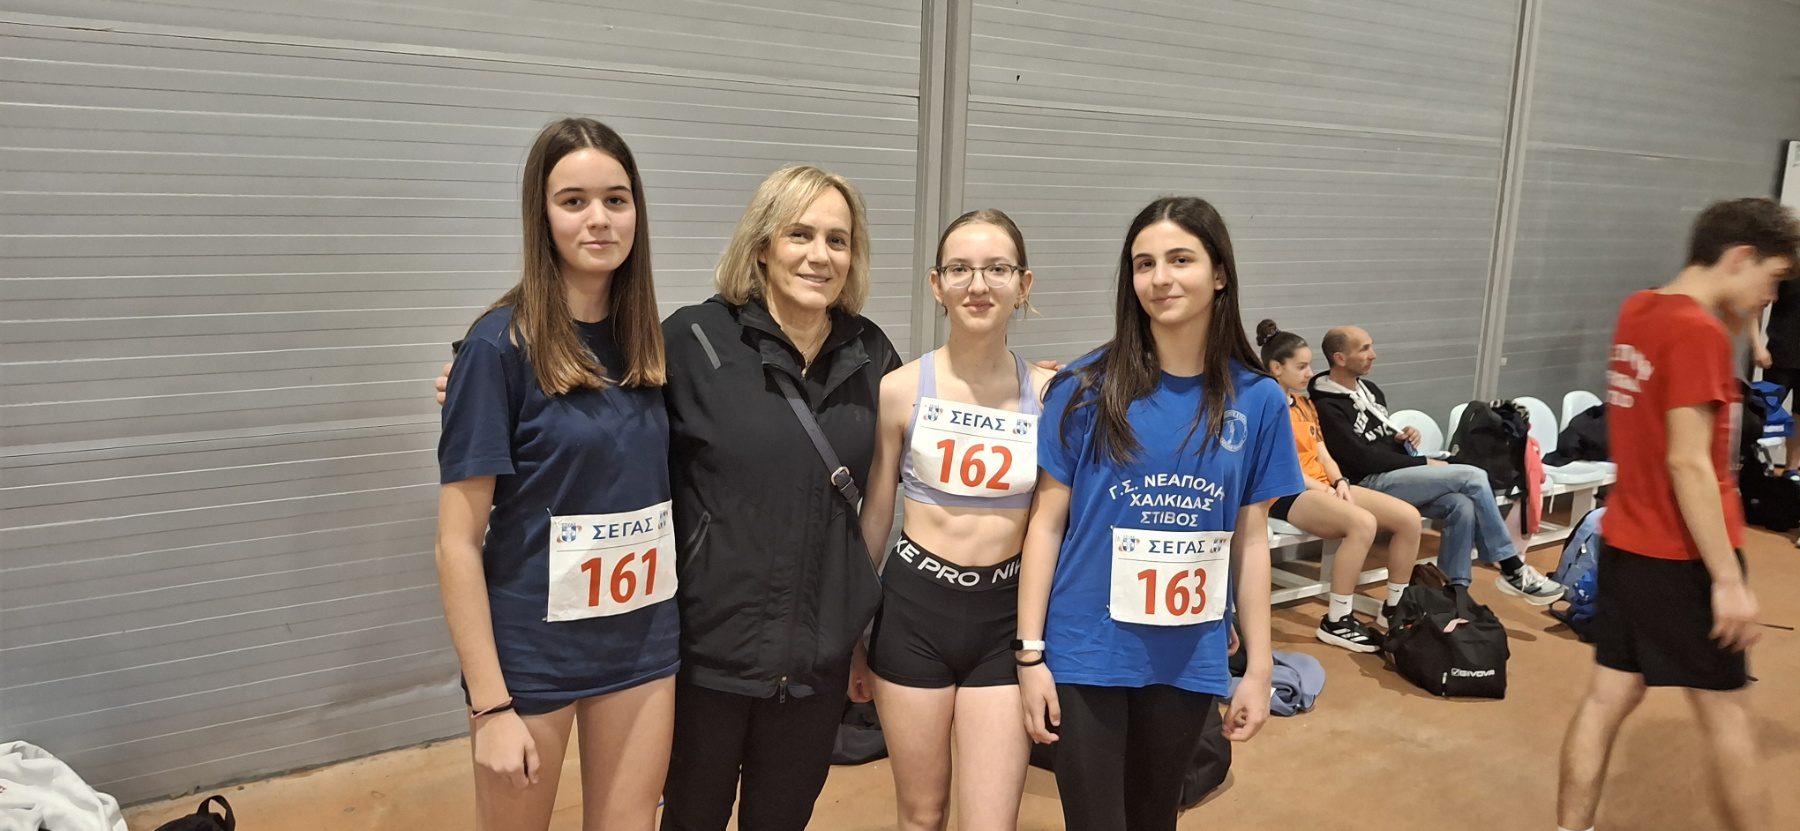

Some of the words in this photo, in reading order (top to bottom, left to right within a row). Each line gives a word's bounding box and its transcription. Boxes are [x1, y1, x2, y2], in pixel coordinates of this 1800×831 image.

[950, 410, 1006, 432] ΣΕΓΑΣ
[937, 438, 1013, 490] 162
[1109, 479, 1139, 500] Γ.Σ.
[1129, 493, 1214, 511] ΧΑΛΚΙΔΑΣ
[592, 517, 654, 540] ΣΕΓΑΣ
[1140, 511, 1199, 527] ΣΤΙΒΟΣ
[1148, 539, 1205, 554] ΣΕΓΑΣ
[581, 547, 656, 607] 161
[917, 557, 980, 587] PRO
[1137, 567, 1207, 616] 163
